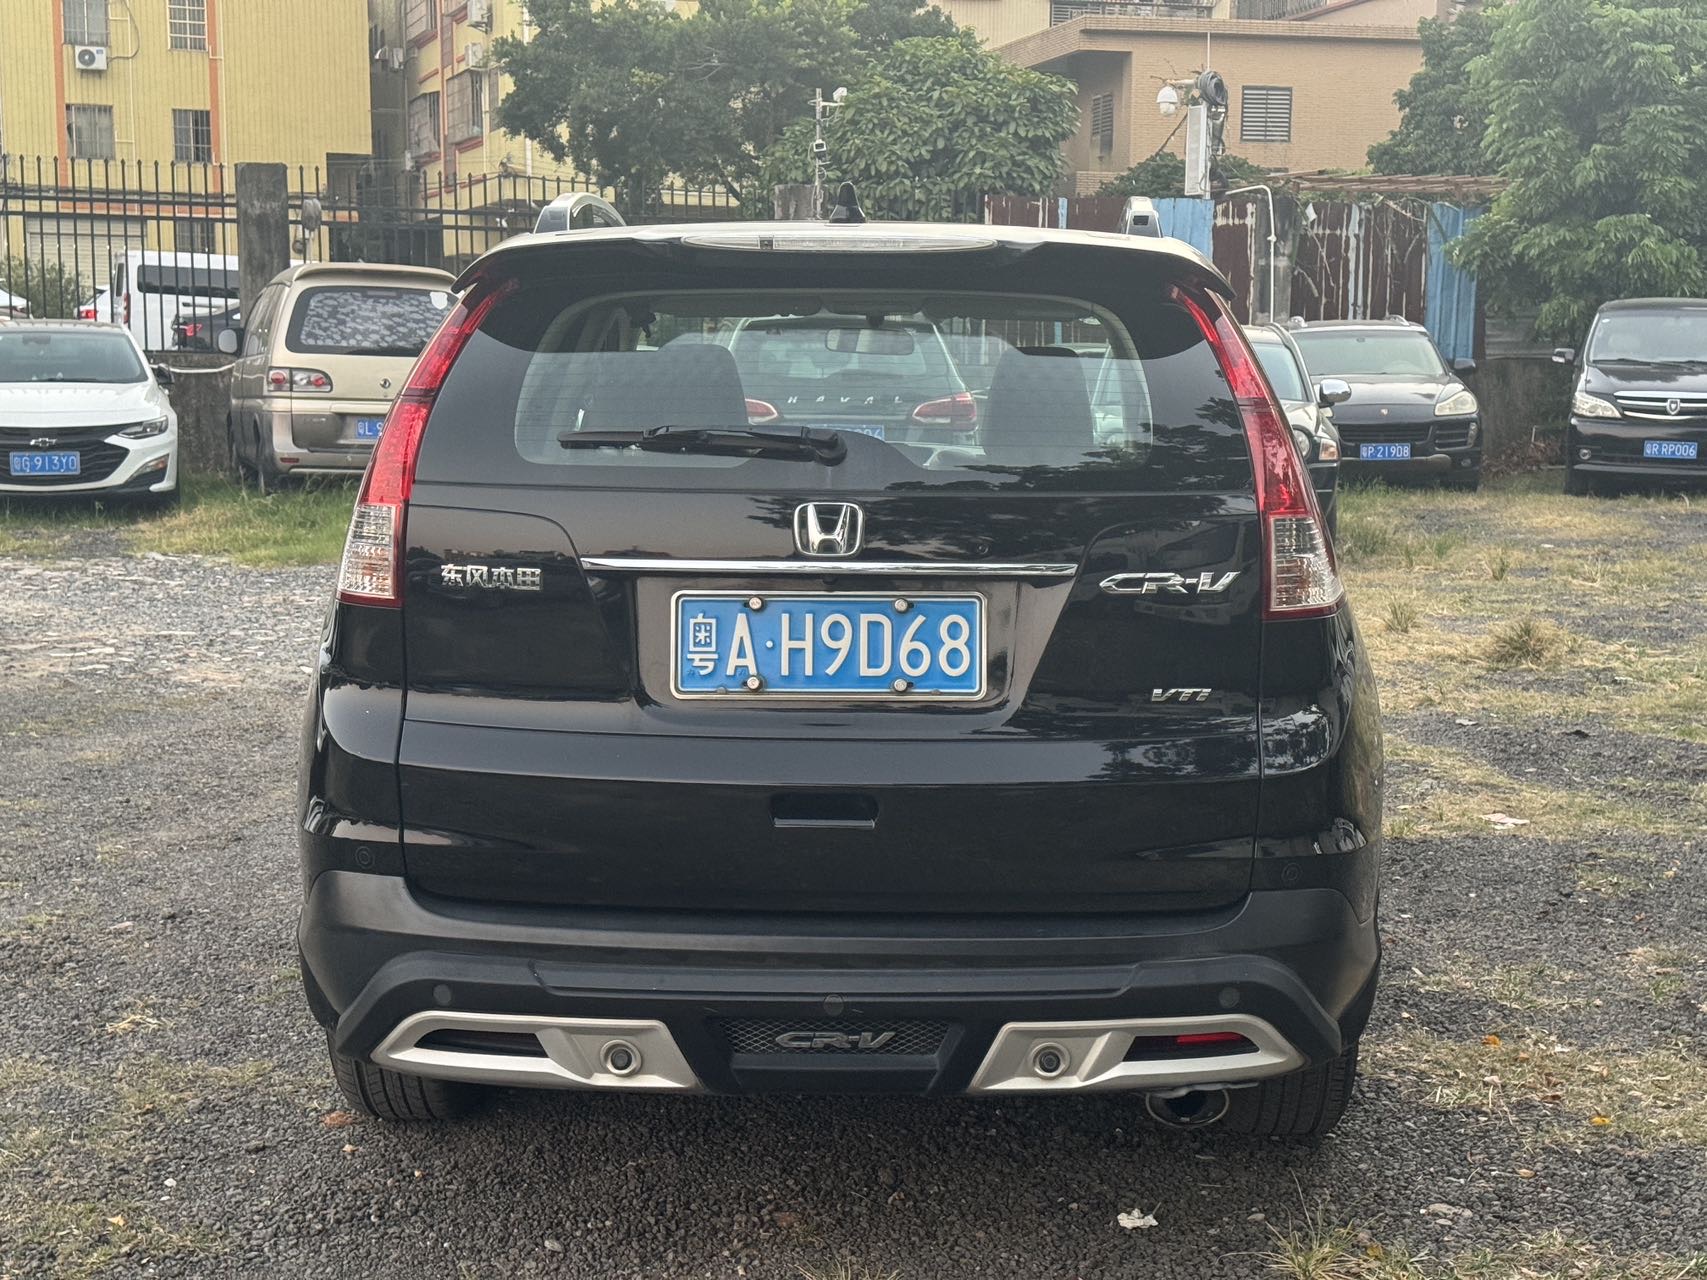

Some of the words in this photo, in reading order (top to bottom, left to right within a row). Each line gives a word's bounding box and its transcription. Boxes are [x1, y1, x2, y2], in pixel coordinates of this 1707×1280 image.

[440, 563, 542, 591] 东风本田
[1099, 571, 1241, 594] CR-V
[775, 1031, 896, 1049] CR-V
